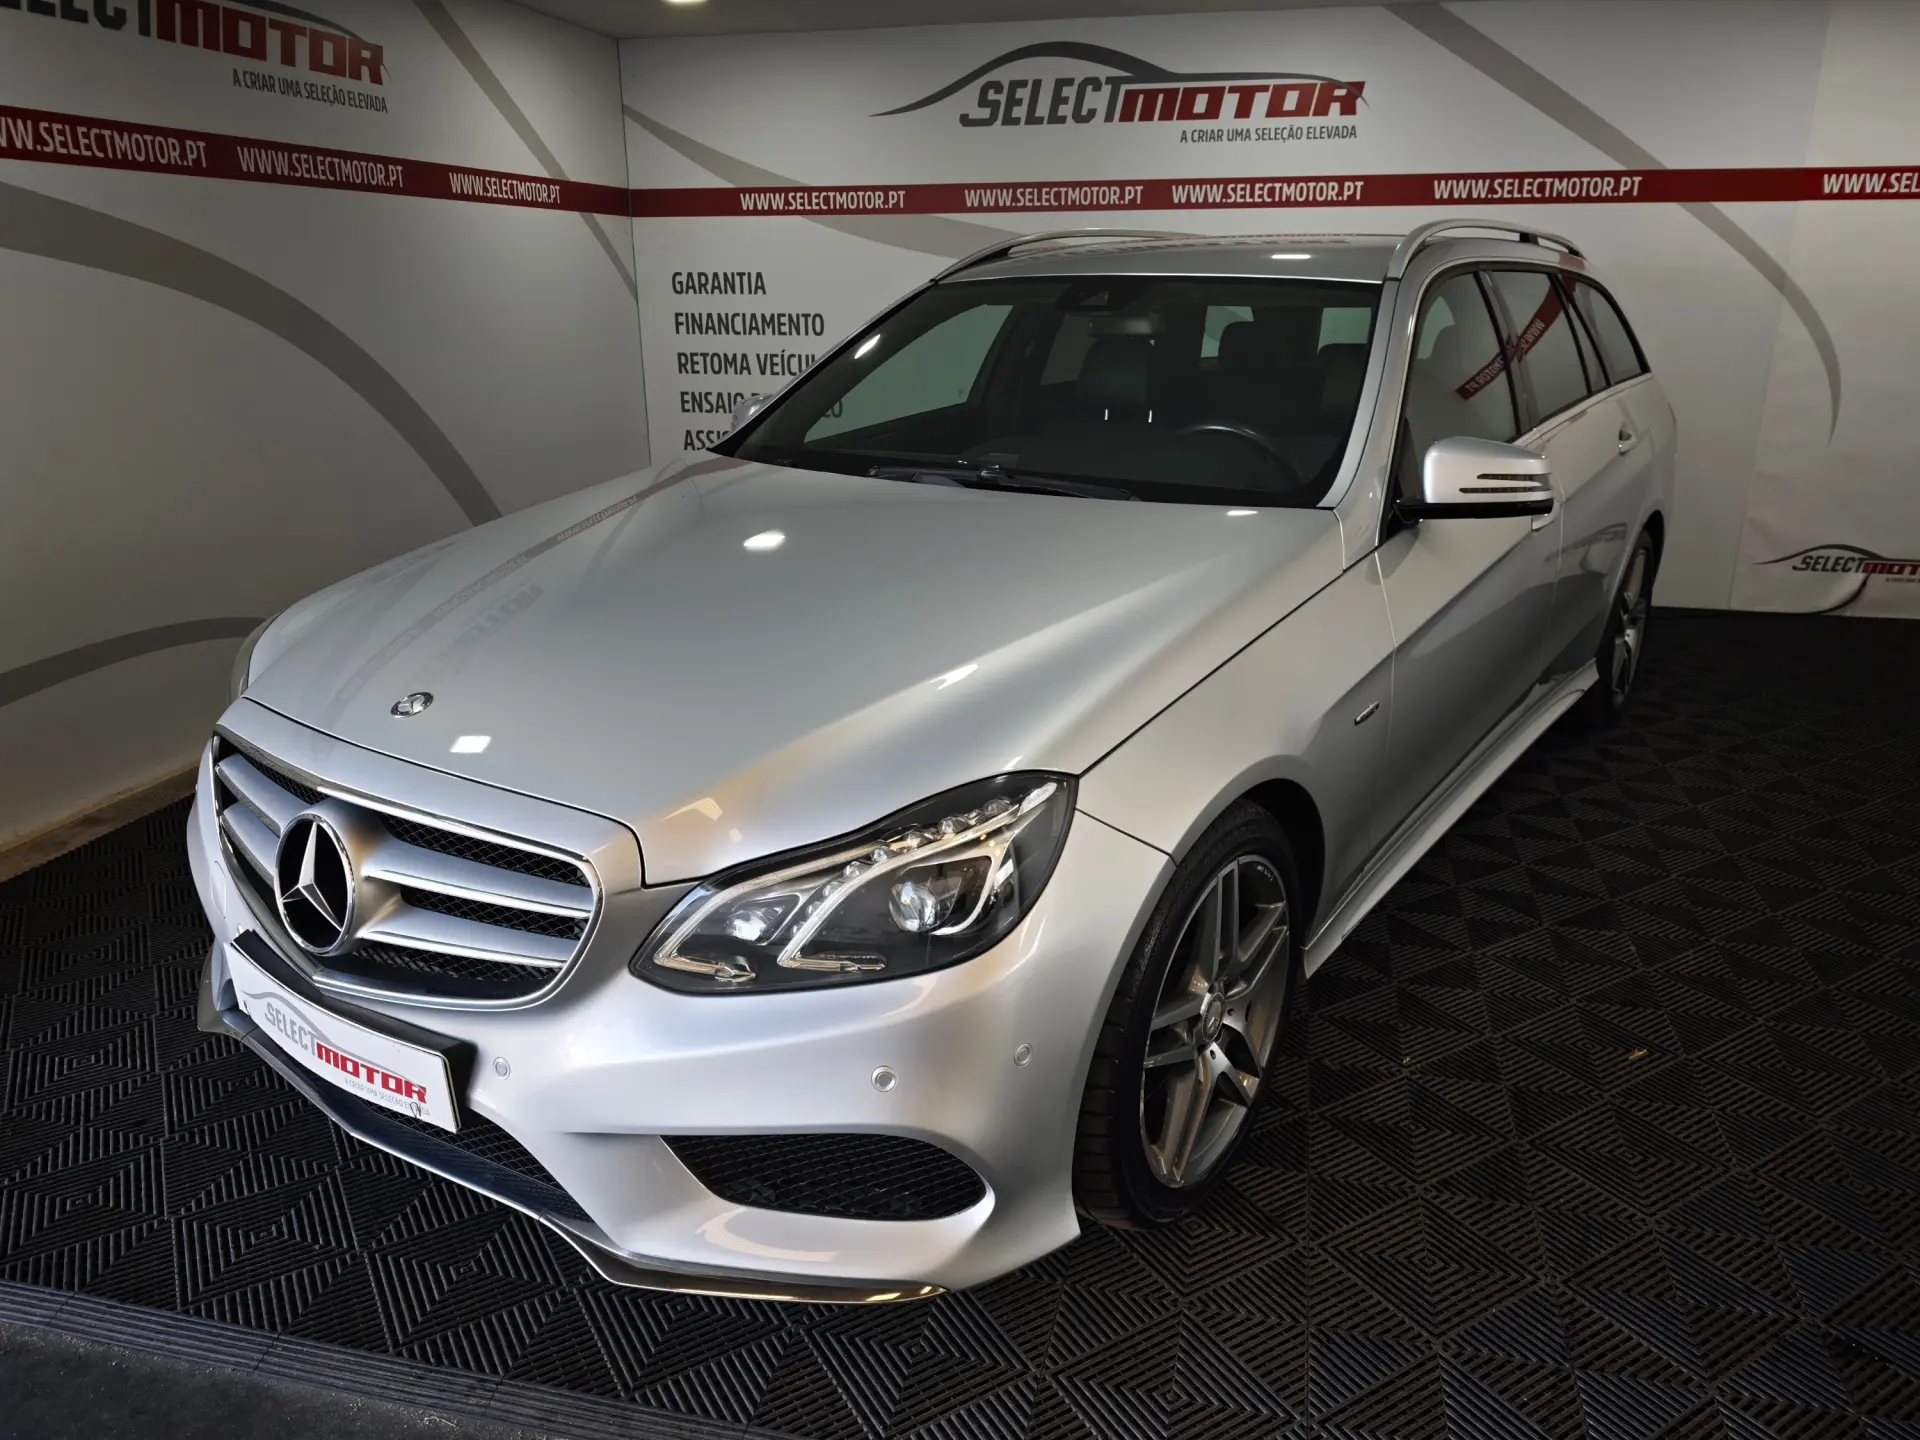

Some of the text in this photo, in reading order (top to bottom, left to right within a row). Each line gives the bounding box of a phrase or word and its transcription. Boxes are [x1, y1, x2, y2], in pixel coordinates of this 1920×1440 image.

[233, 68, 388, 114] A CRIAR UMA SELEÇÃO ELEVADA
[1180, 125, 1357, 143] A CRIAR UMA SELEÇÃO ELEVADA
[237, 145, 403, 188] WWW.SELECTMOTOR.PT
[449, 172, 560, 204] WWW.SELECTMOTOR.PT
[964, 185, 1144, 207] WWW.SELECTMOTOR.PT
[1171, 181, 1365, 204] WWW.SELECTMOTOR.PT
[1433, 176, 1643, 200] WWW.SELECTMOTOR.PT
[740, 190, 906, 211] WWW.SELECTMOTOR.PT
[671, 271, 767, 295] GARANTIA
[674, 312, 825, 336] FINANCIAMENTO
[677, 352, 752, 375] RETOMA
